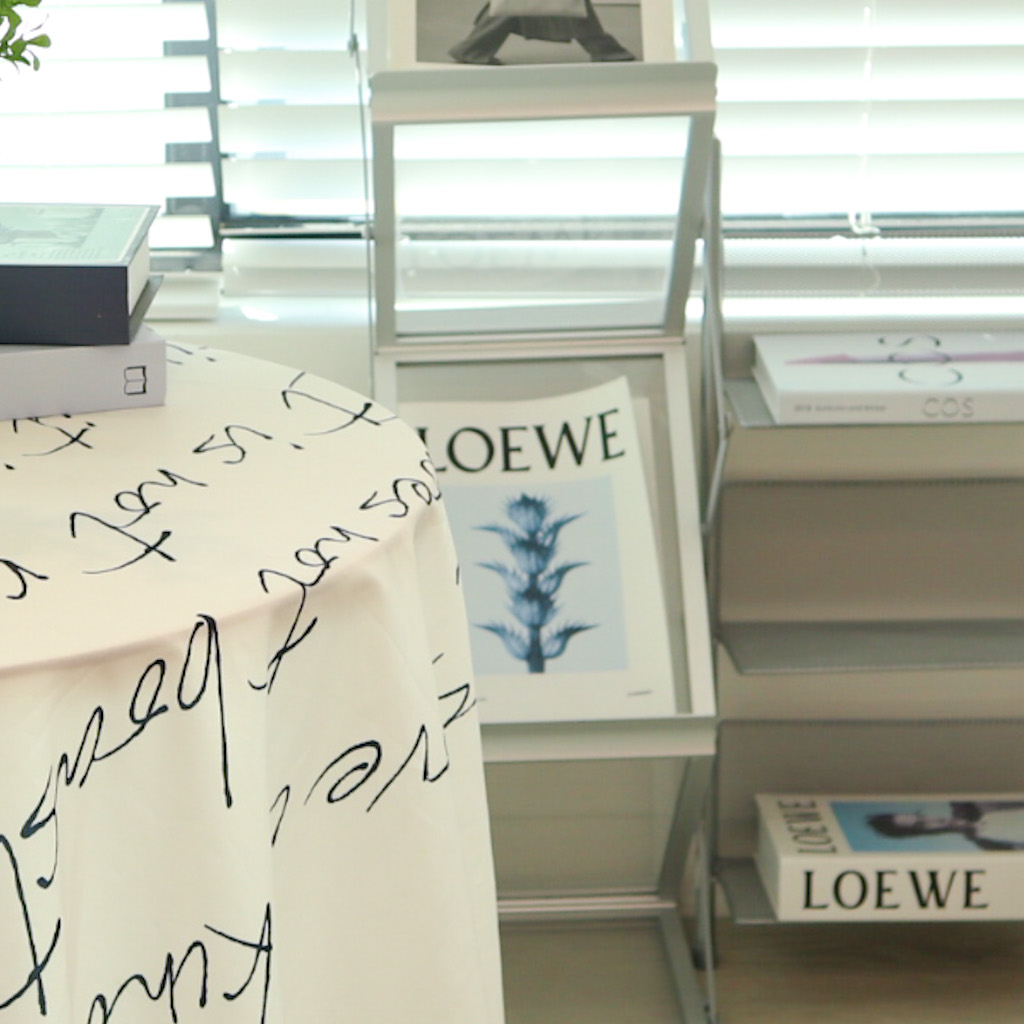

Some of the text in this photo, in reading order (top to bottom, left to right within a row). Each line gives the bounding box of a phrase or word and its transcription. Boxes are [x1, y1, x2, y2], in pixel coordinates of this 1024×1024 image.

[922, 397, 975, 418] COS
[778, 800, 837, 853] LOEWE
[802, 869, 989, 910] LOEWE
